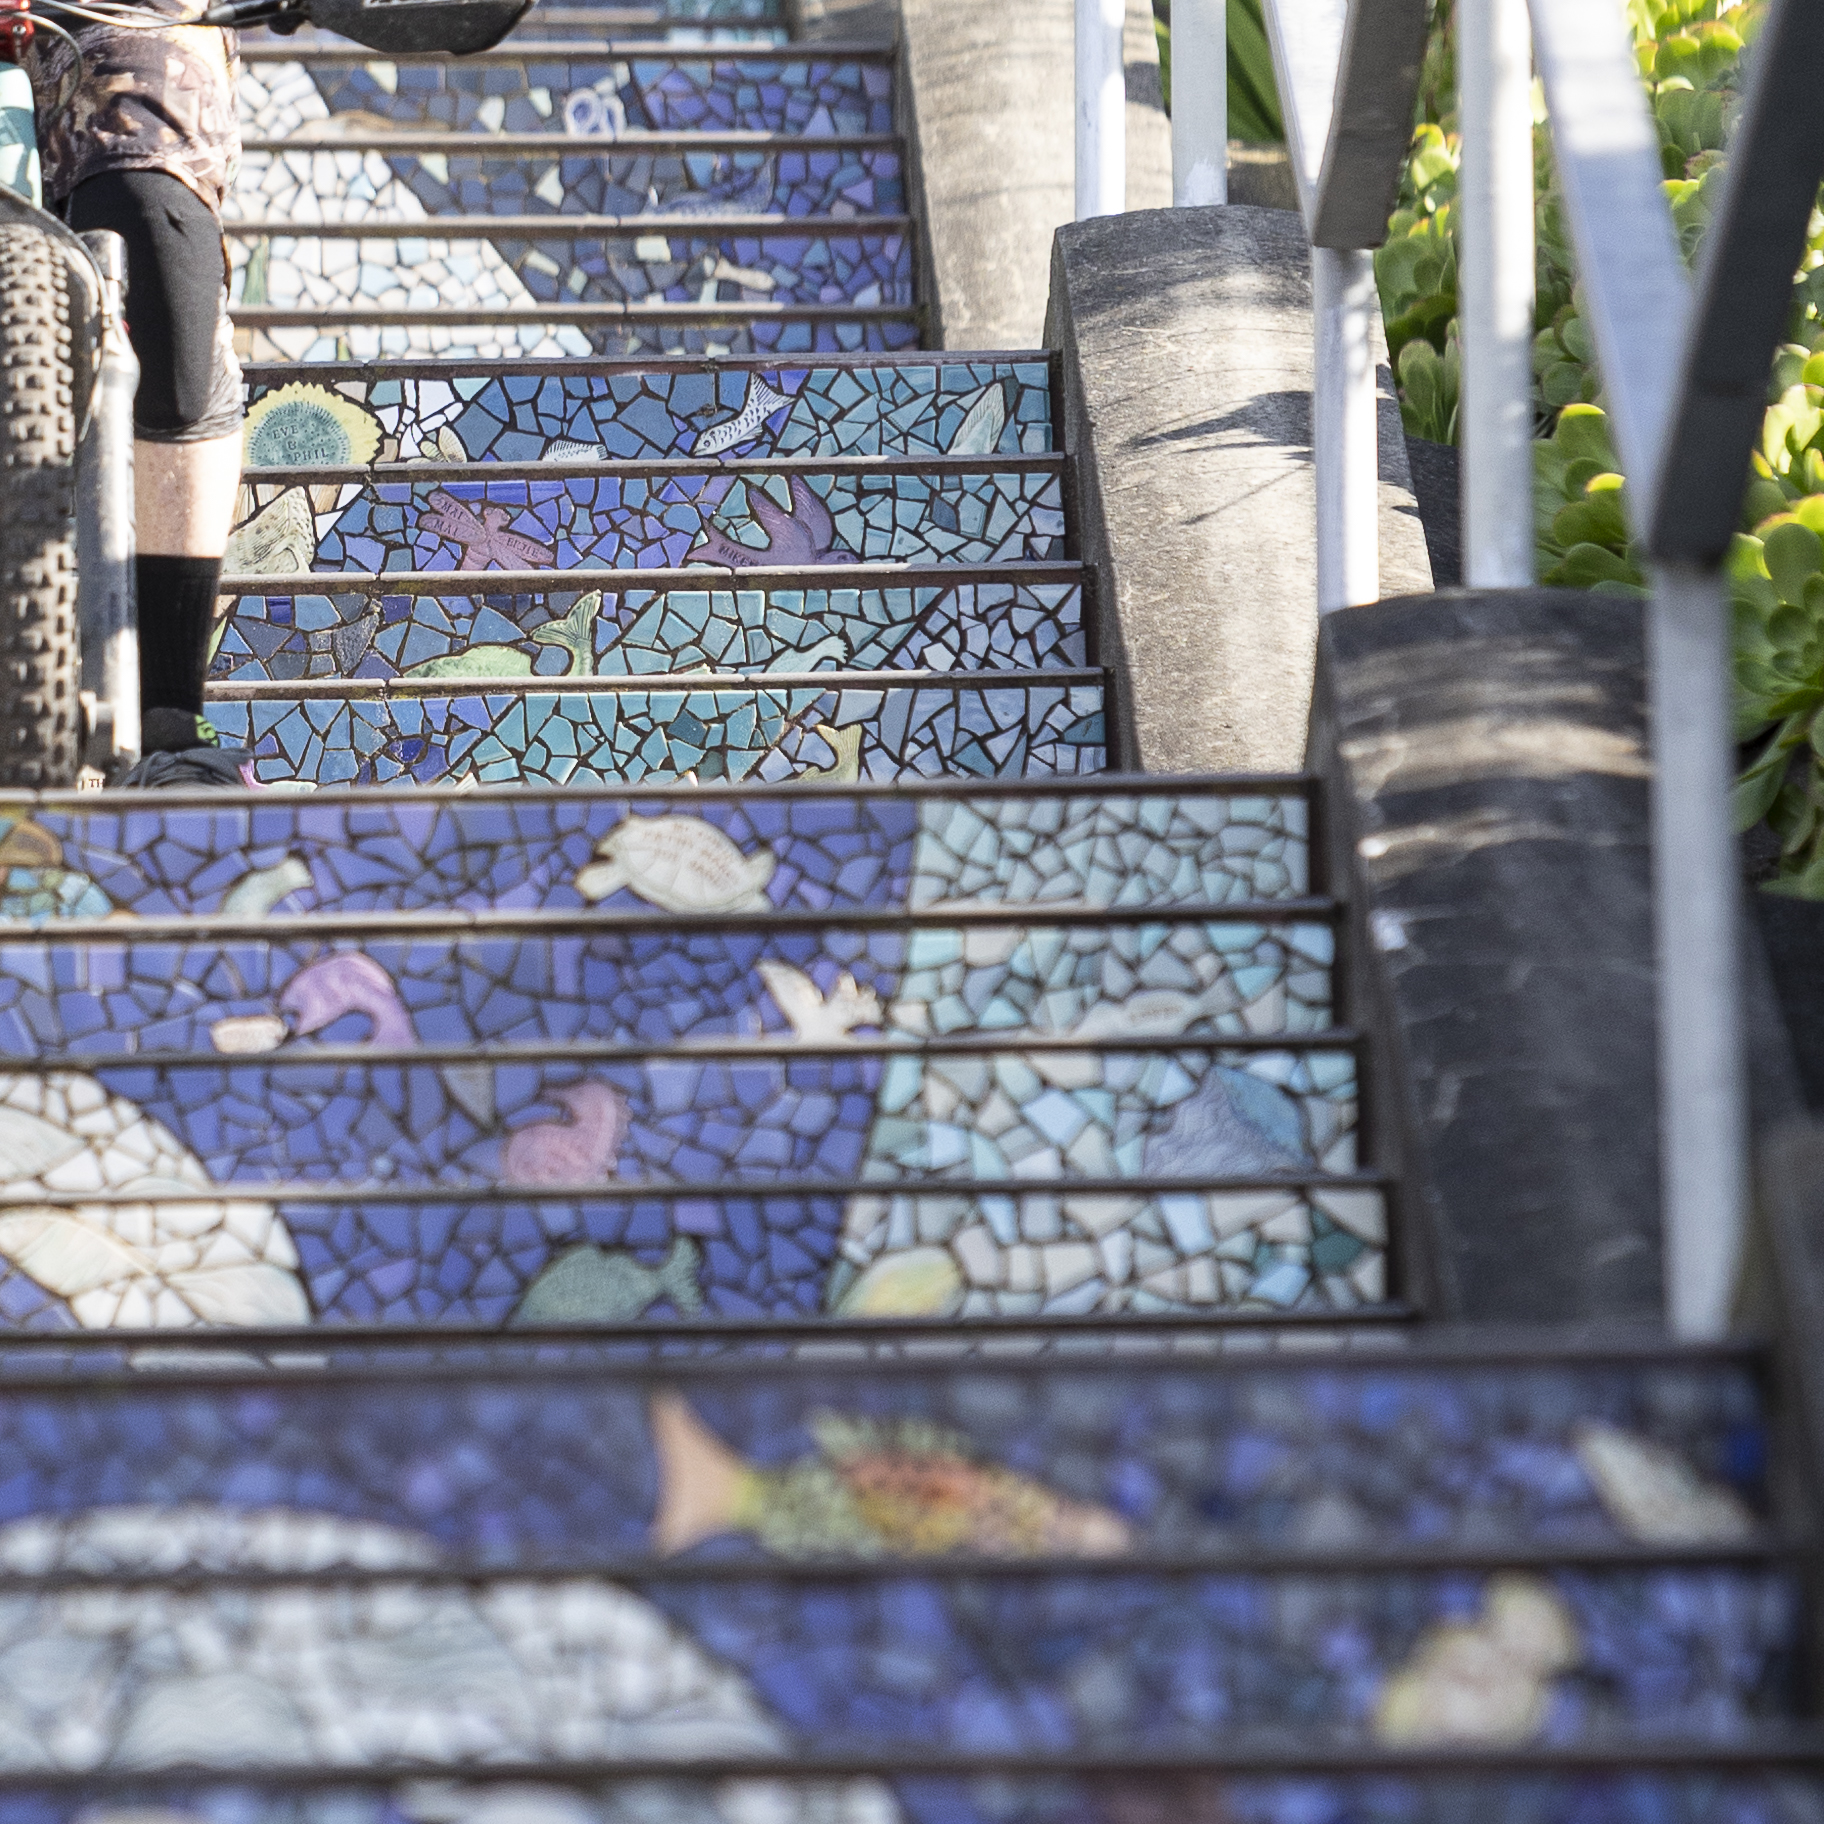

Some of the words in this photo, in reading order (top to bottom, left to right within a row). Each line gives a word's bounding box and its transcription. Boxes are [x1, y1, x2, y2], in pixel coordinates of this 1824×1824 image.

[272, 424, 299, 440] EVE
[293, 447, 330, 462] PHIL
[441, 501, 465, 520] MAI
